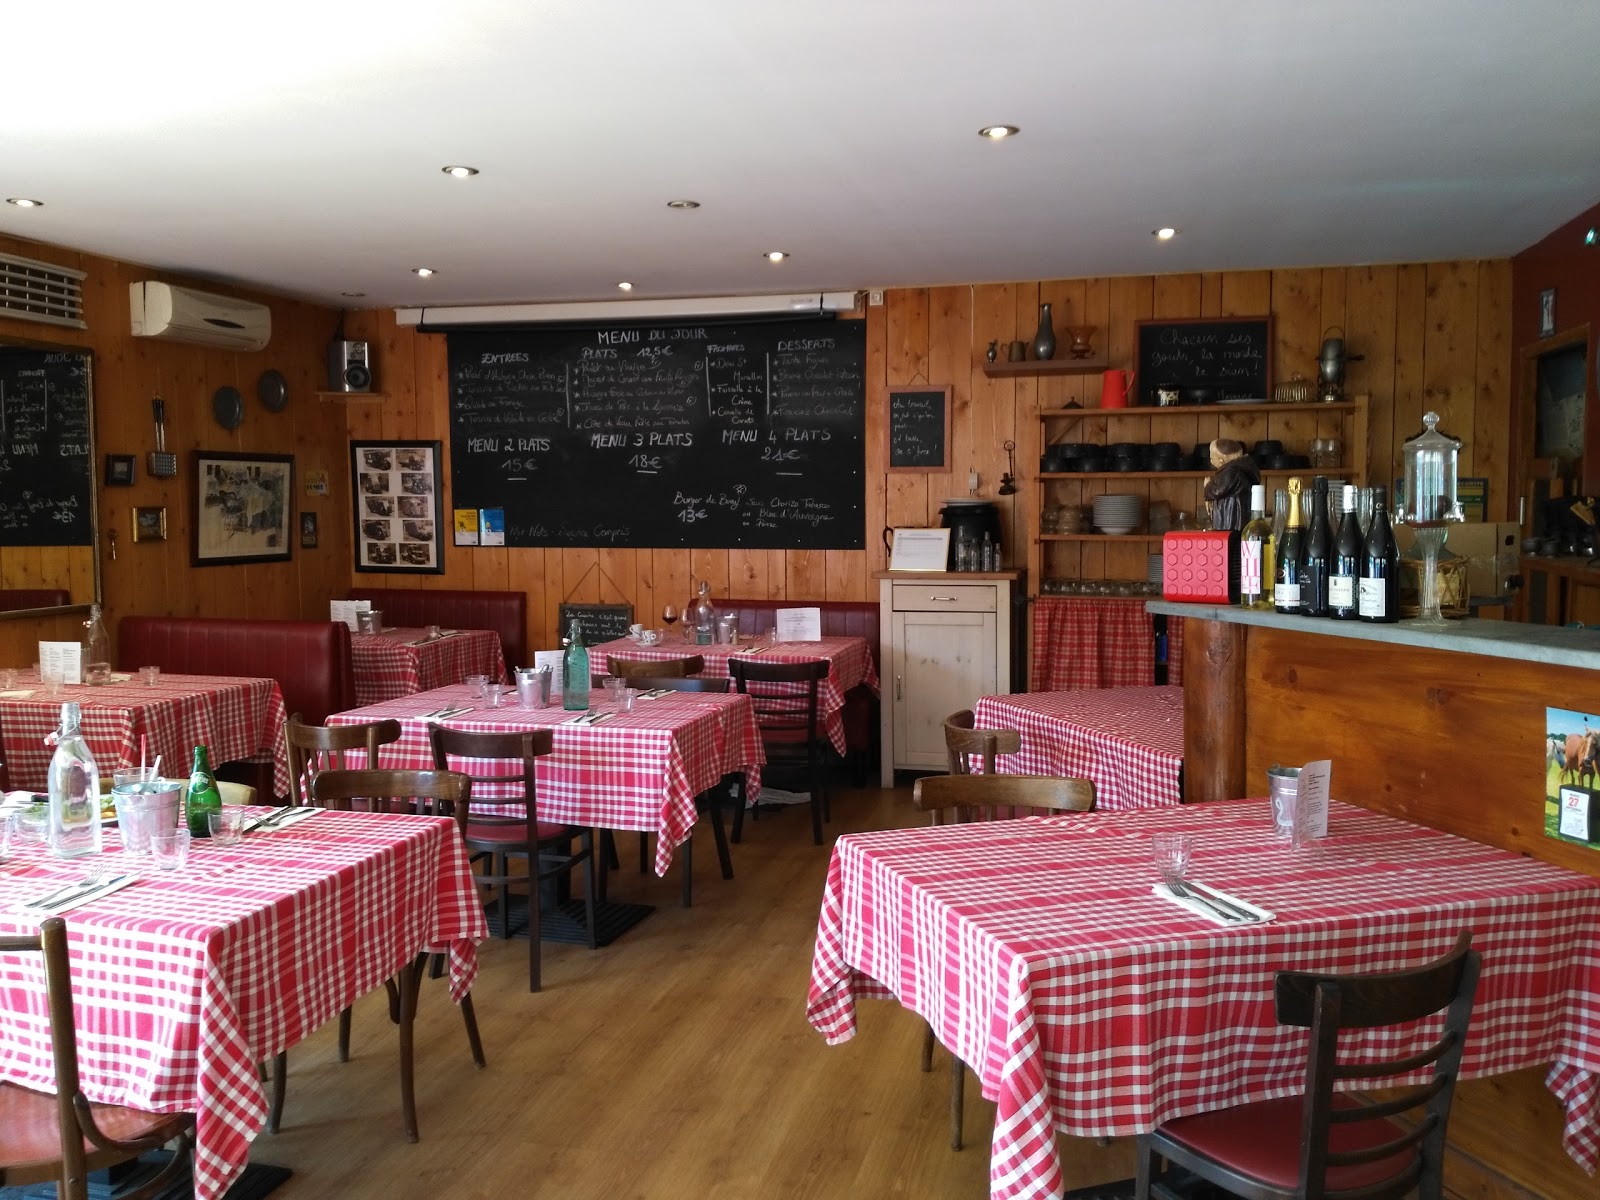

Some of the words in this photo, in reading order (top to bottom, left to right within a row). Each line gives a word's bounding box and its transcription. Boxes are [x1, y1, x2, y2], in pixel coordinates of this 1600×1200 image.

[597, 331, 640, 349] MENU
[647, 330, 666, 341] DU
[671, 328, 709, 342] JOUR
[777, 338, 836, 352] DESSERTS
[1159, 329, 1218, 346] Chacun
[480, 352, 529, 364] ENTREES
[582, 348, 617, 359] PLATS
[591, 434, 628, 449] MENU
[632, 434, 644, 446] 3
[649, 433, 693, 447] PLATS
[722, 429, 758, 445] MENU
[768, 431, 778, 445] 4
[785, 429, 832, 443] PLATS
[467, 438, 500, 453] MENU
[503, 438, 516, 452] 2
[518, 438, 552, 452] PLATS
[501, 457, 539, 473] 15€
[627, 454, 662, 470] 18€
[673, 491, 702, 508] Burger
[706, 494, 717, 504] de
[678, 508, 708, 523] 13€
[1568, 796, 1579, 808] 27
[1275, 796, 1295, 827] 2
